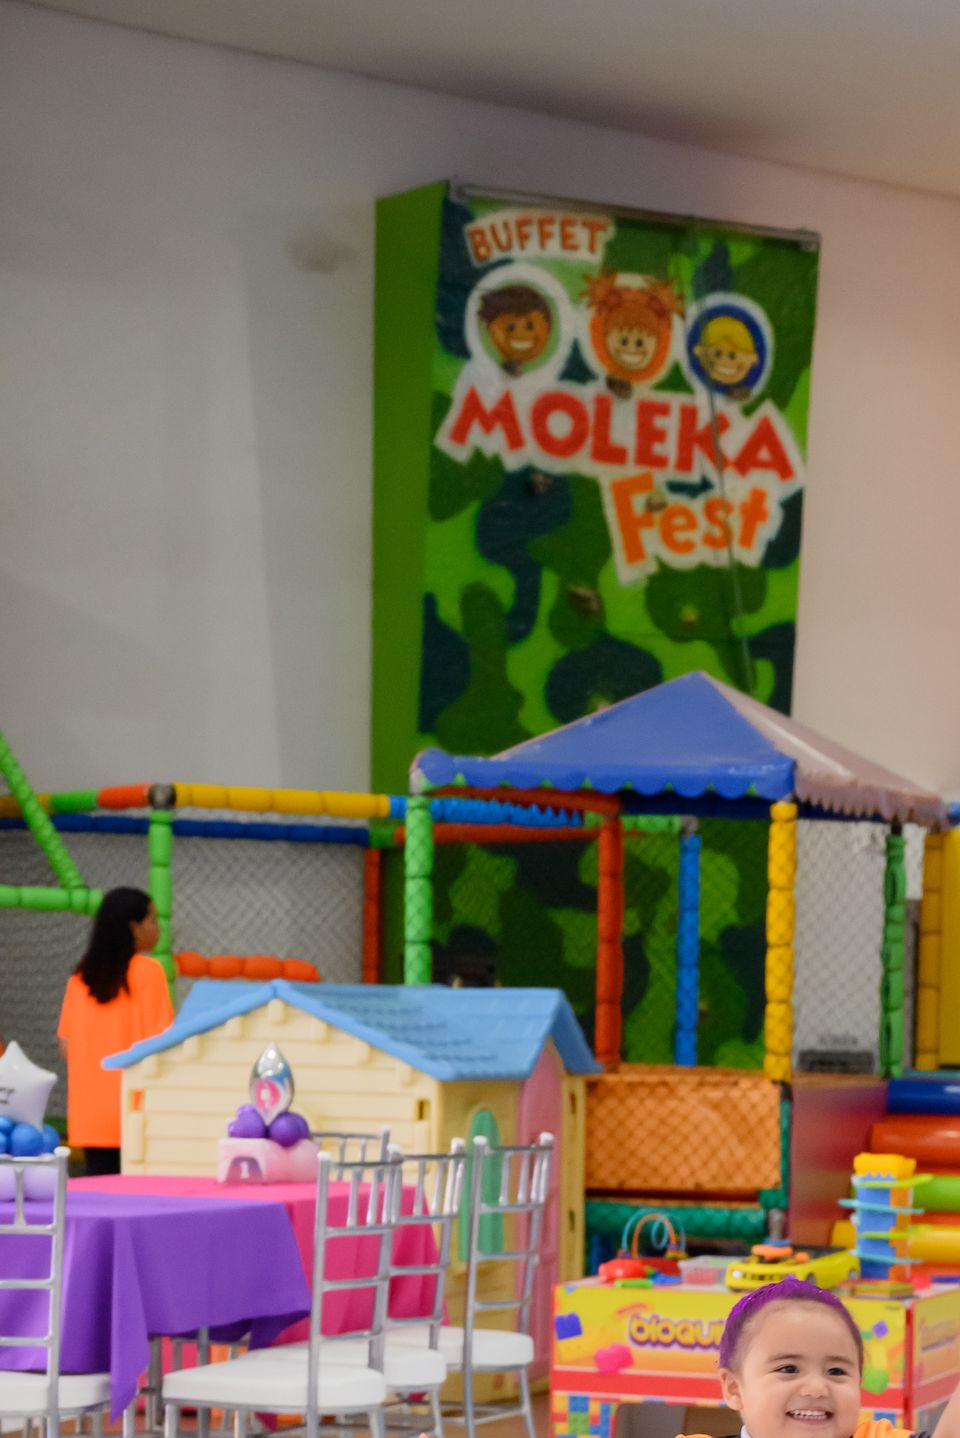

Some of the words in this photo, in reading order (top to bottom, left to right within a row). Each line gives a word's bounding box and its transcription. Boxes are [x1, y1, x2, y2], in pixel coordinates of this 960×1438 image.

[466, 215, 609, 262] BUFFET
[448, 384, 796, 482] MOLEKA
[609, 471, 770, 566] Fest
